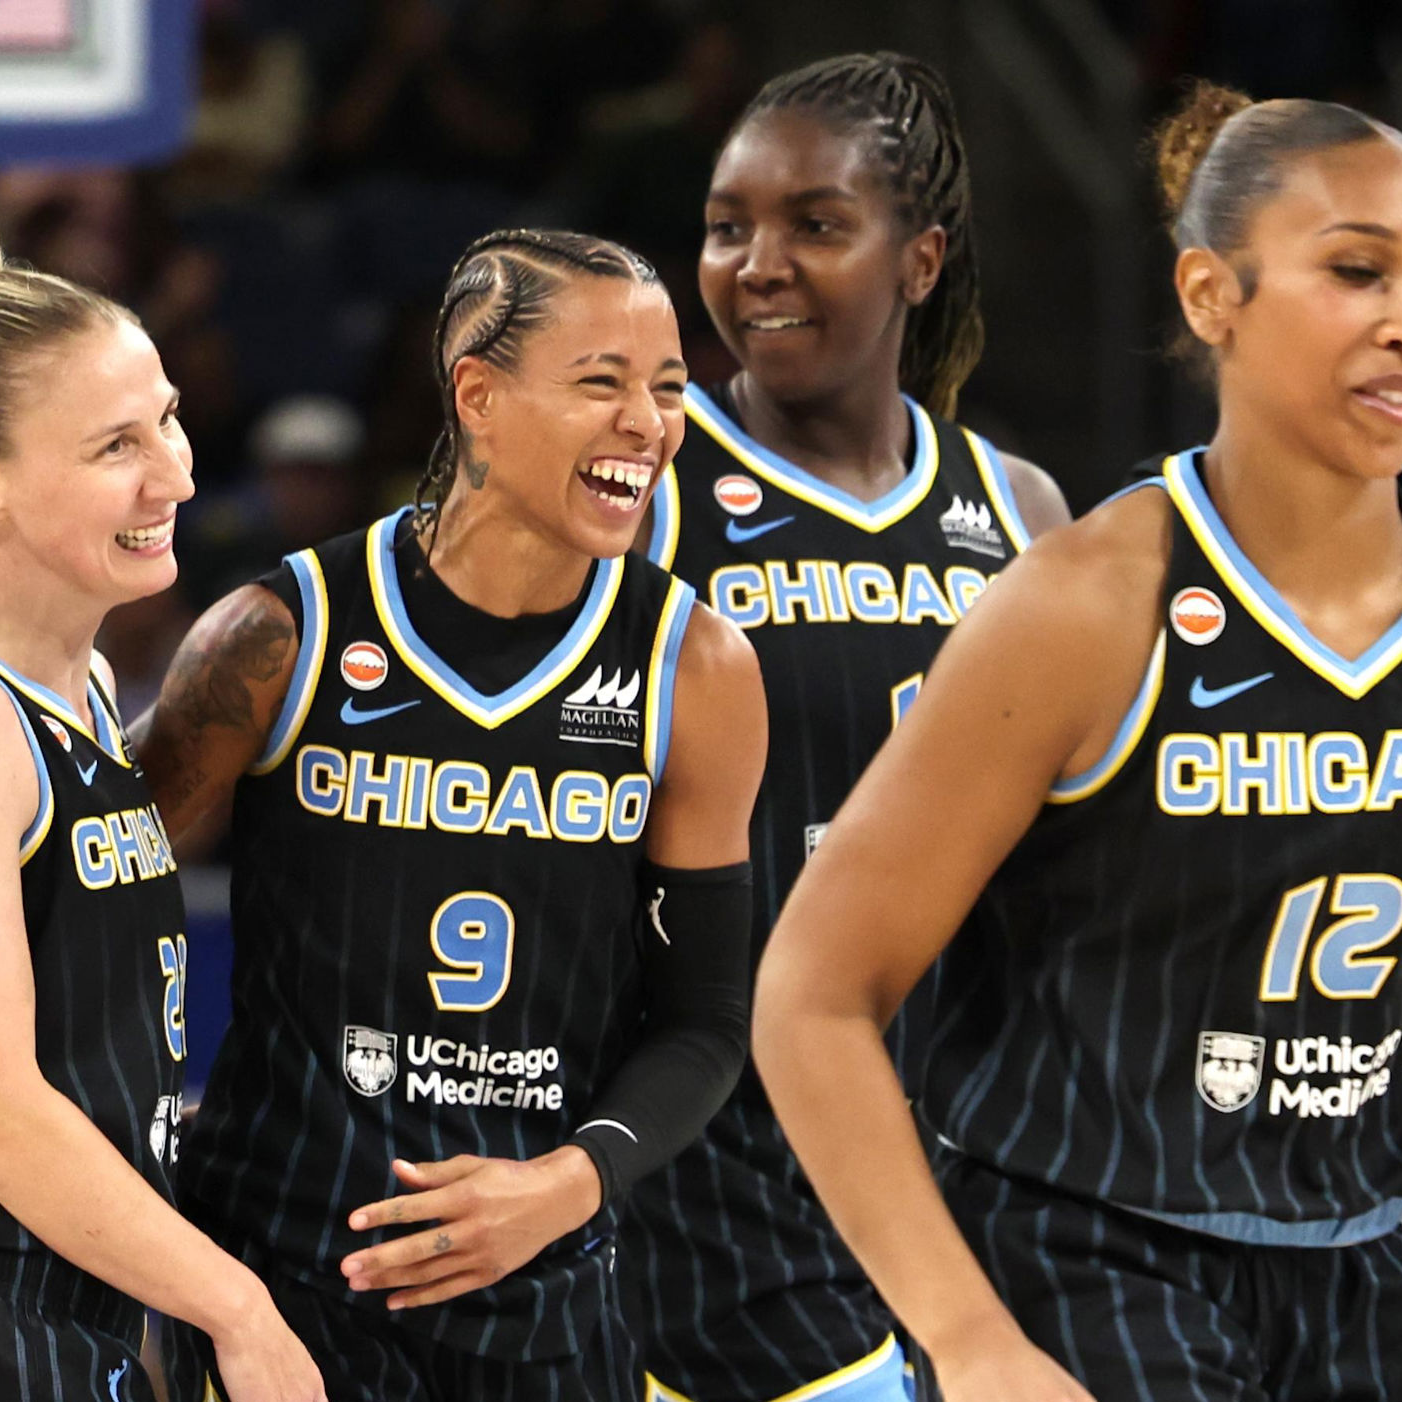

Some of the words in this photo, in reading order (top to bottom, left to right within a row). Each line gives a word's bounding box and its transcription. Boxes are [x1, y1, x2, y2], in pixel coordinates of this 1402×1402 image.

[710, 560, 999, 626] CHICAG
[296, 743, 653, 845] CHICAGO
[71, 802, 178, 891] CHIC
[427, 890, 516, 1012] 9
[406, 1034, 560, 1080] UChicago
[406, 1070, 564, 1111] Medicine
